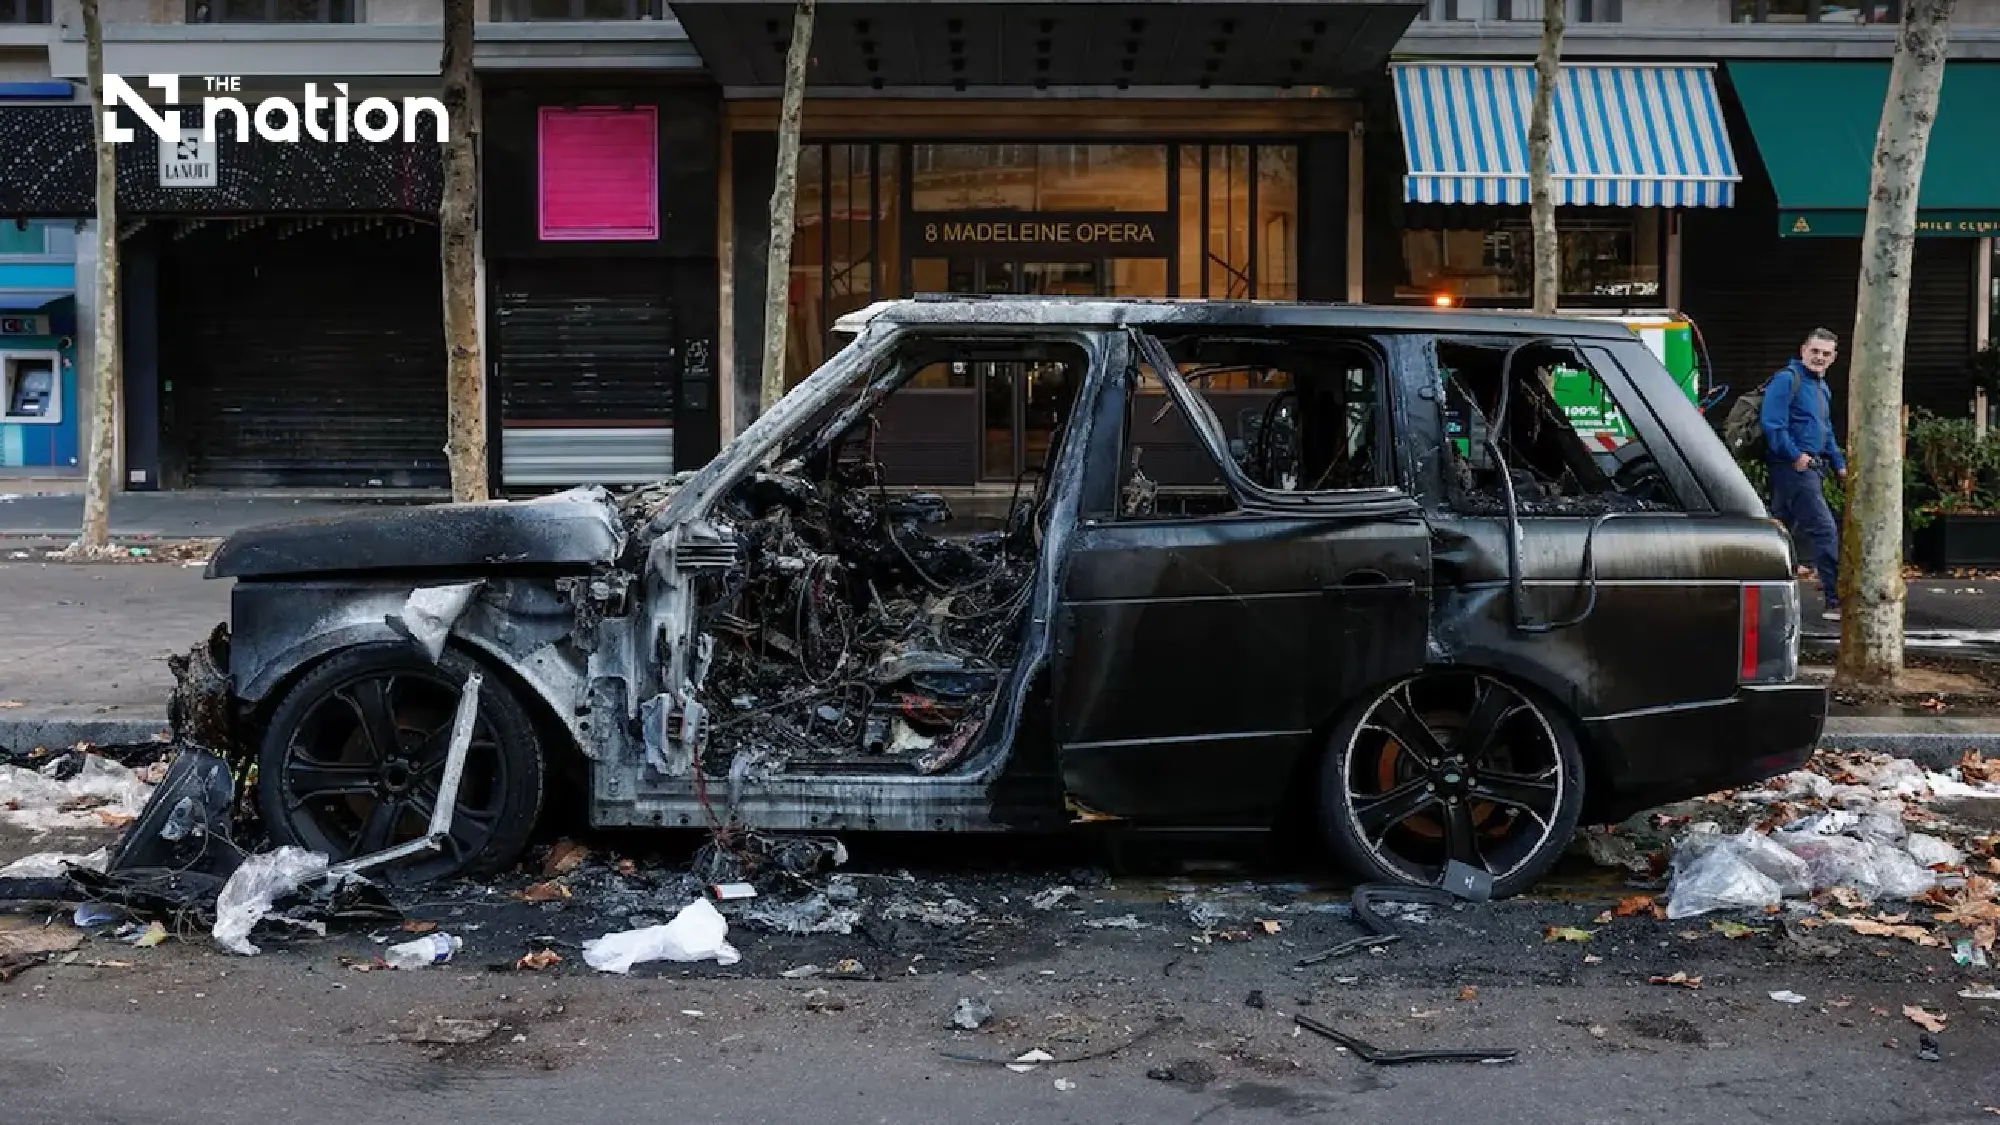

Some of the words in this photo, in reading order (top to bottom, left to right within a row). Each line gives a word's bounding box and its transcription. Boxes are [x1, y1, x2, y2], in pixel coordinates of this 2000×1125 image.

[925, 222, 938, 243] 8
[943, 222, 1071, 243] MADELEINE
[1077, 222, 1155, 243] OPERA
[1959, 221, 2000, 232] CLINI
[1564, 405, 1599, 417] 100%
